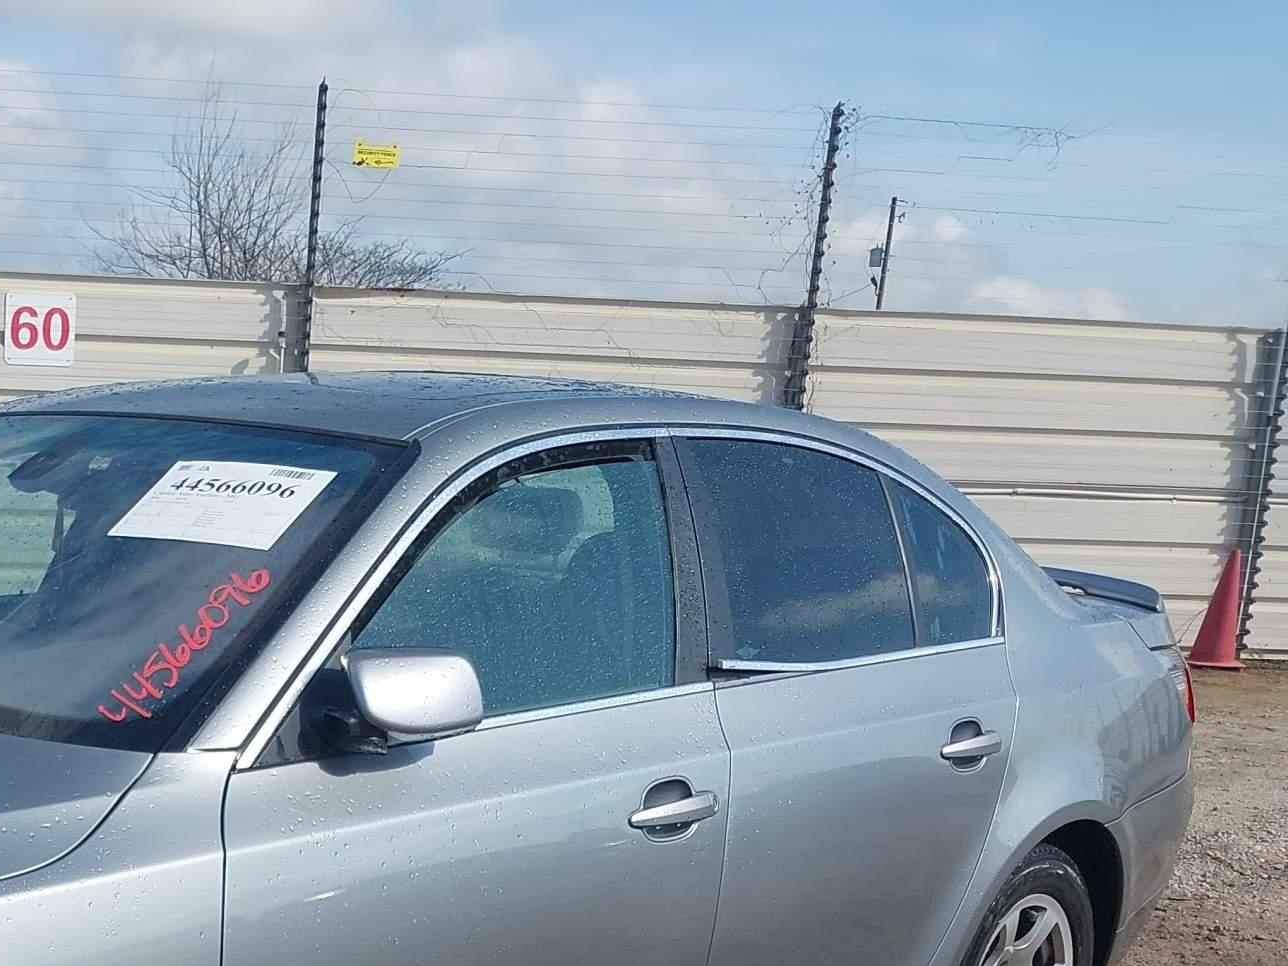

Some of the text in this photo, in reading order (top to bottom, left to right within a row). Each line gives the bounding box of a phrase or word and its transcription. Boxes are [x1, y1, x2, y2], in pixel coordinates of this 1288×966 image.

[10, 306, 70, 351] 60
[170, 477, 301, 499] 44566096
[98, 568, 270, 722] 44566096
